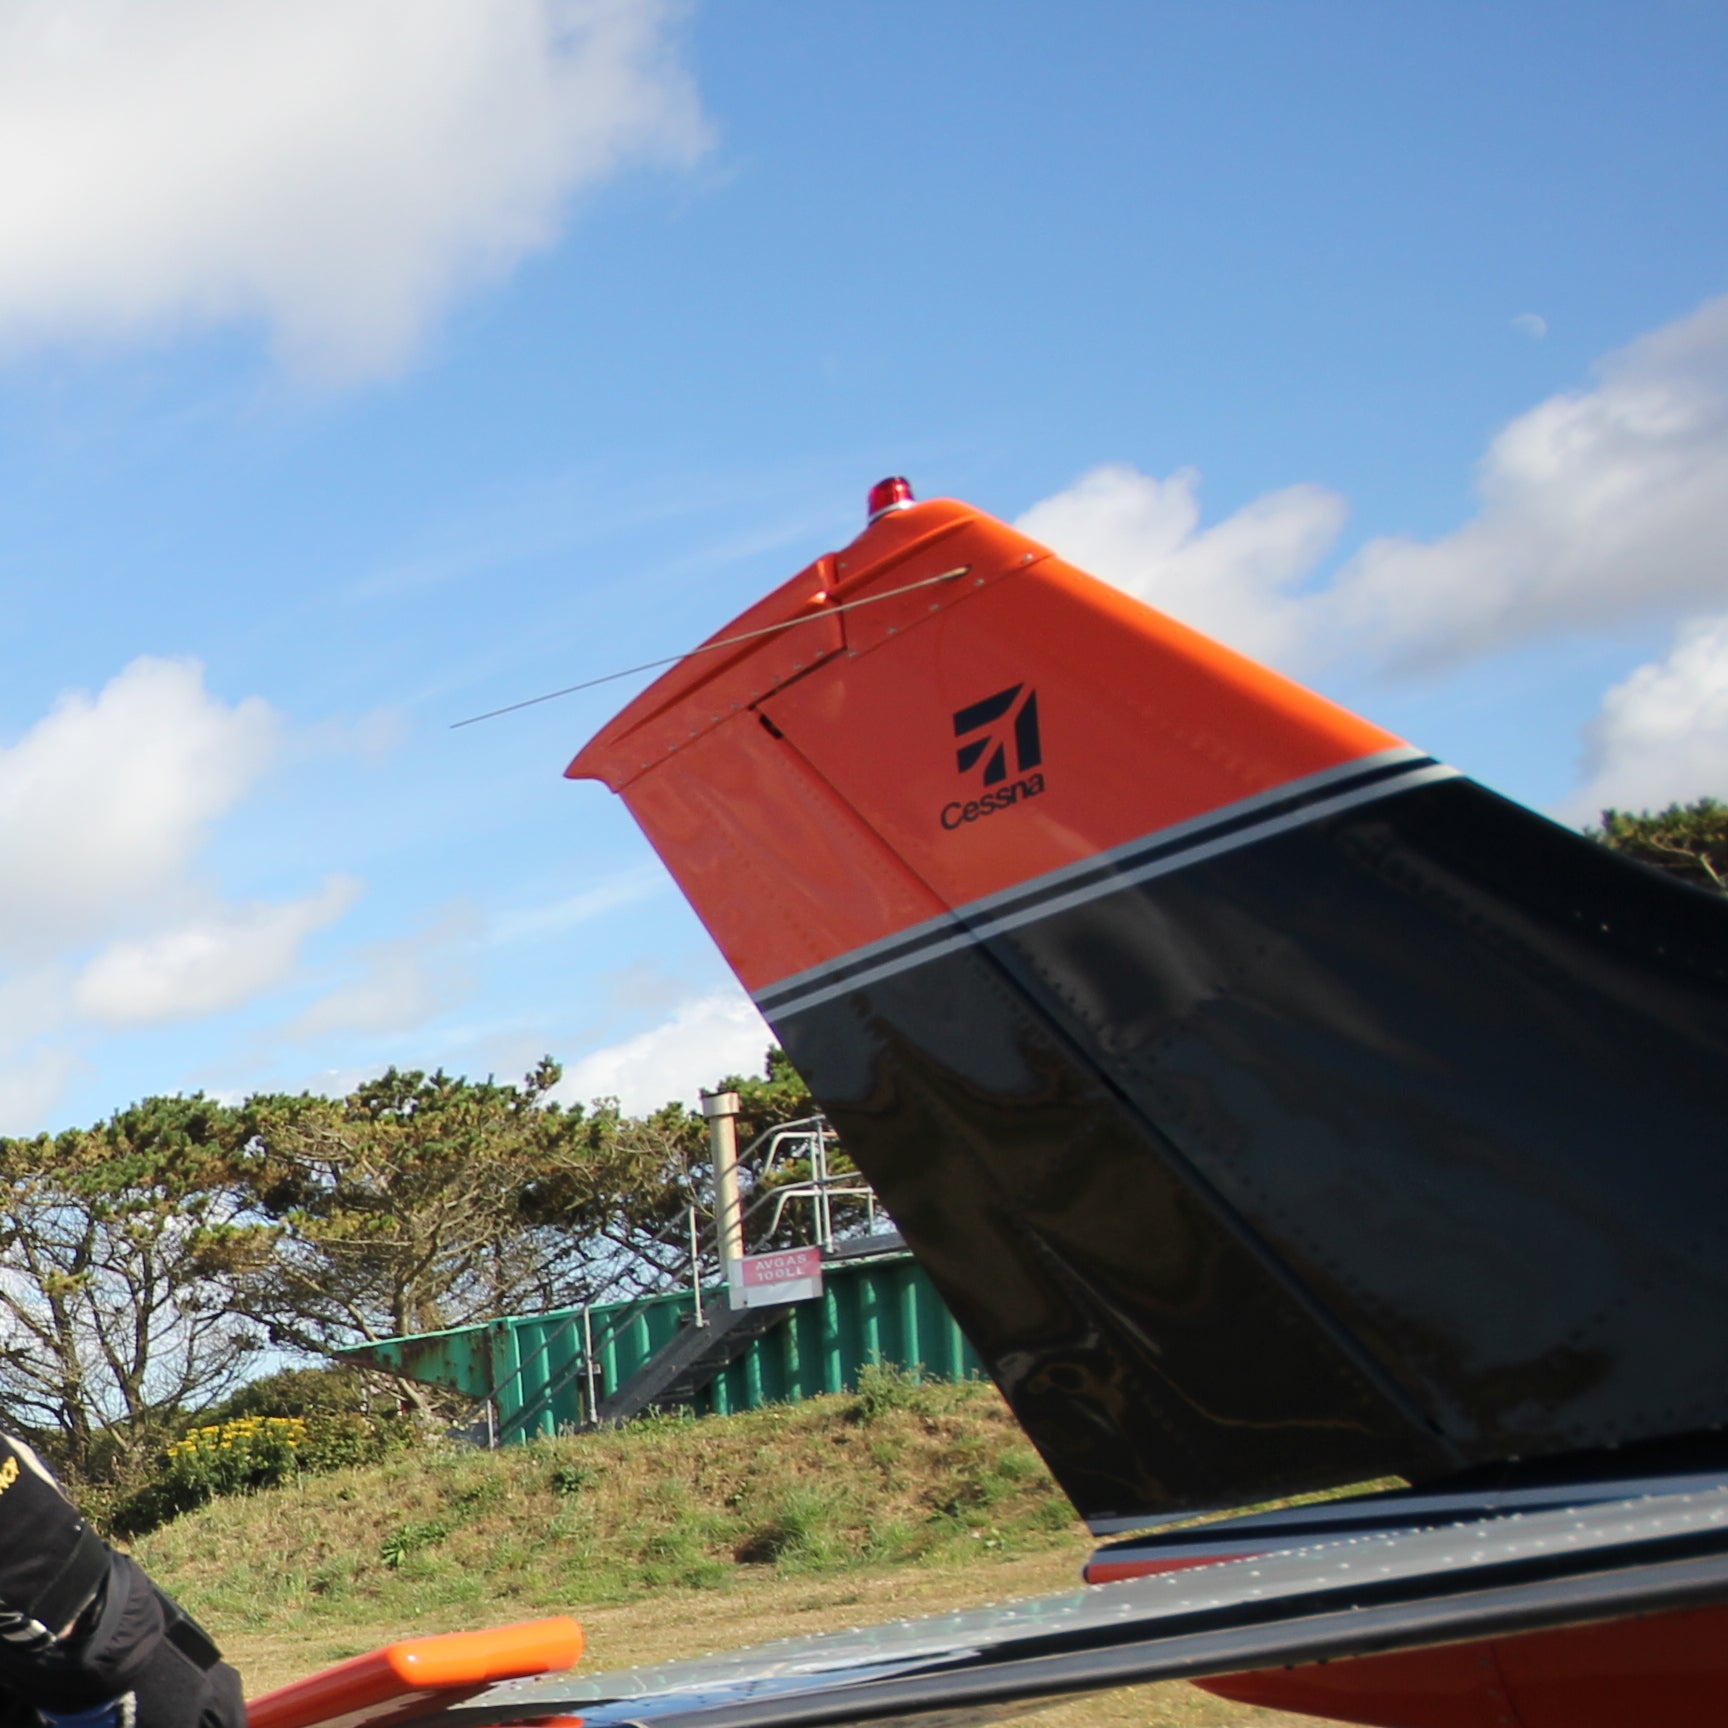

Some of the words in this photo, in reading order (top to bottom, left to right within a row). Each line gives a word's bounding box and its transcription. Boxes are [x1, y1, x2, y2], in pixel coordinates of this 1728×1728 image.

[940, 772, 1045, 831] Cessna
[755, 1253, 807, 1271] AVGAS
[757, 1266, 806, 1281] 100LL
